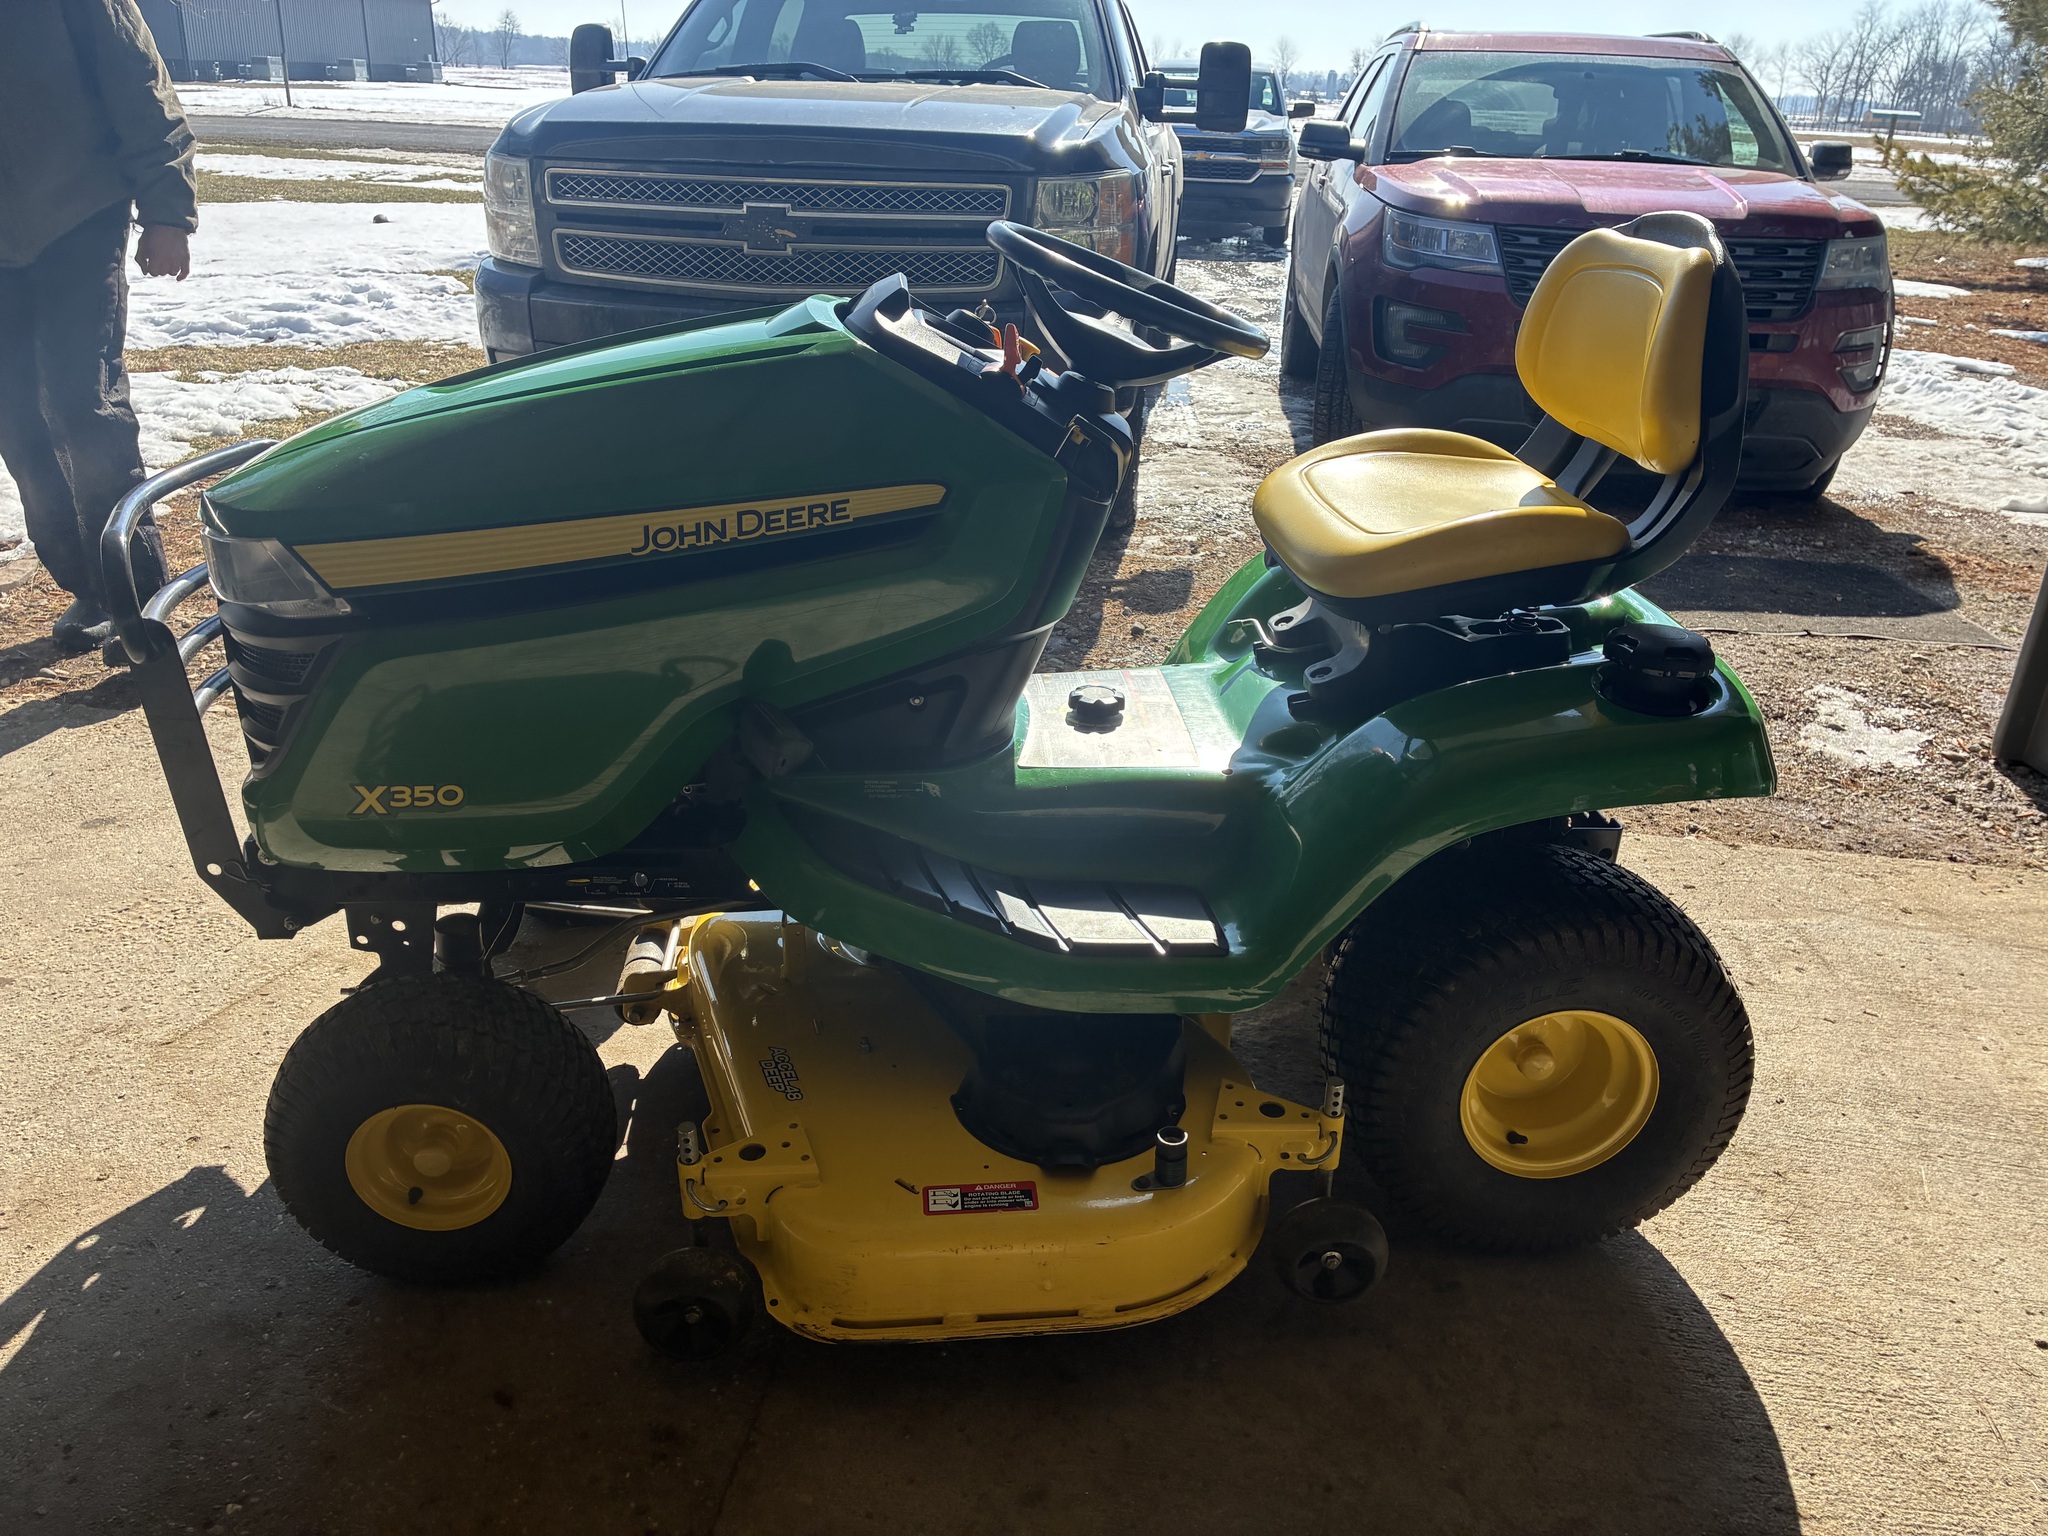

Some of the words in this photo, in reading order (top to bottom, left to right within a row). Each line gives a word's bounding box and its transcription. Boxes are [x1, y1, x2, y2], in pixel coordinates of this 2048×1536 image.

[631, 518, 728, 554] JOHN
[736, 498, 851, 538] DEERE
[352, 784, 465, 814] X350
[759, 1060, 787, 1093] DEEP
